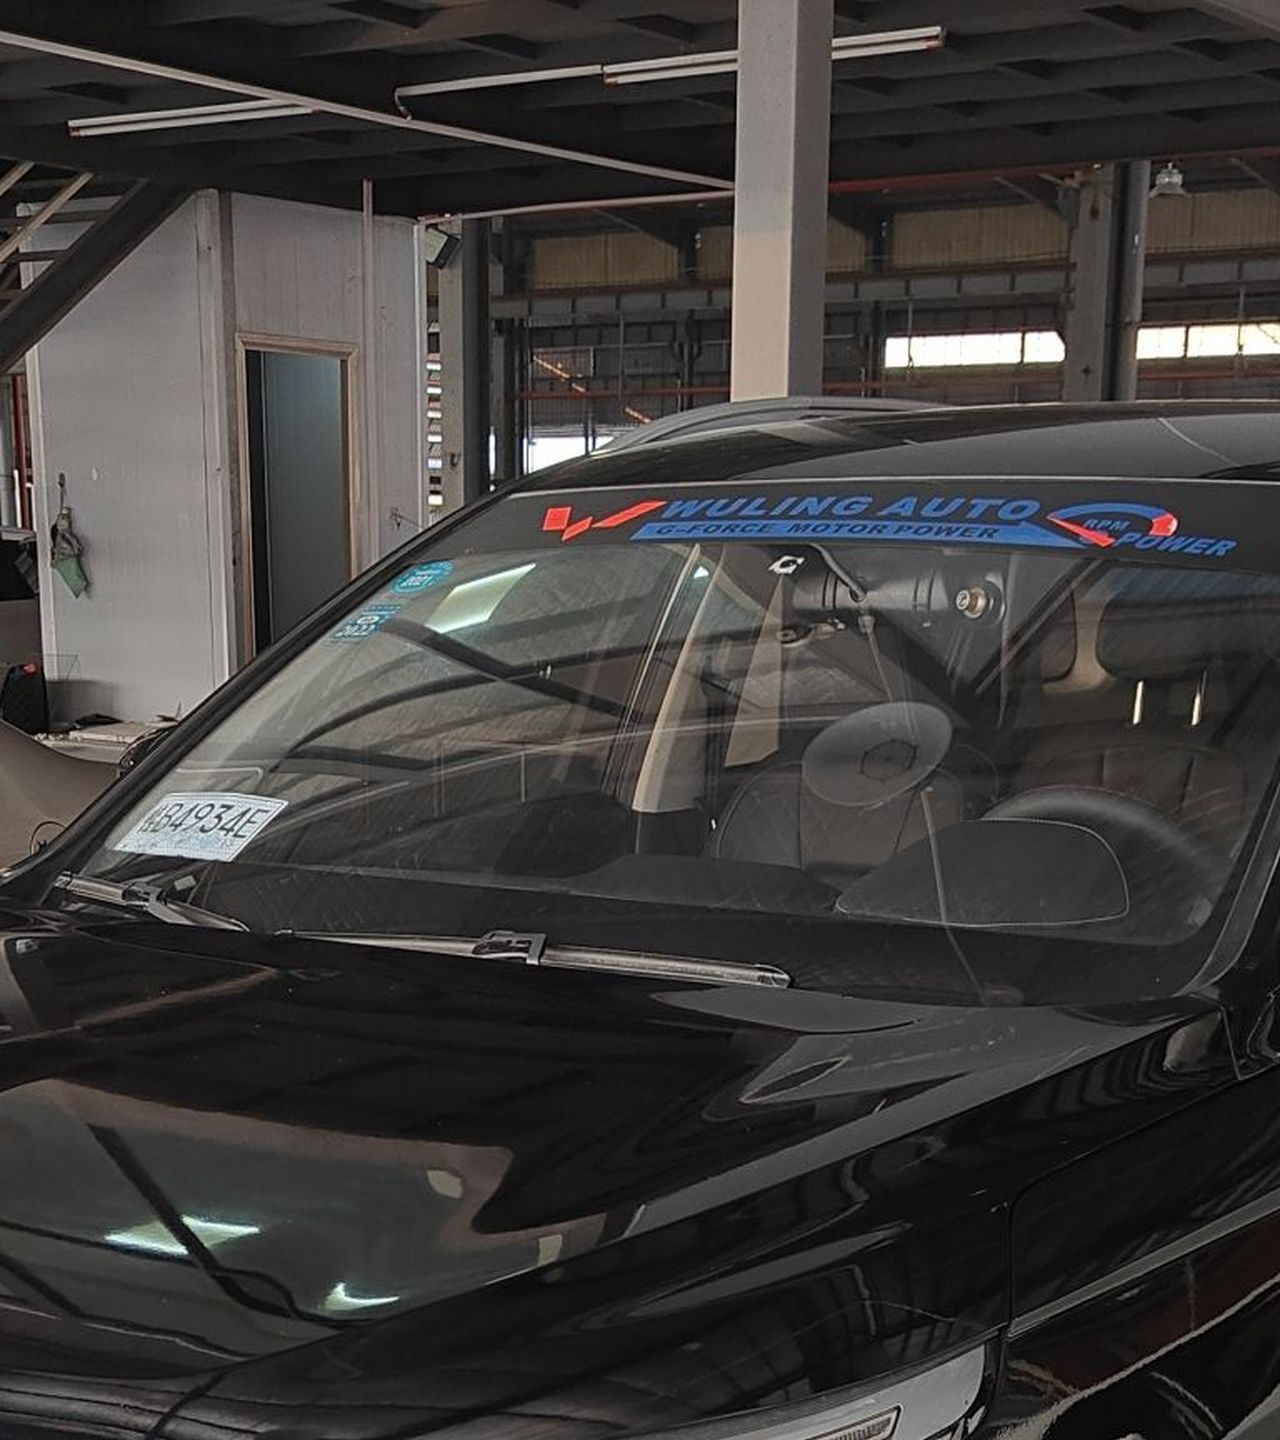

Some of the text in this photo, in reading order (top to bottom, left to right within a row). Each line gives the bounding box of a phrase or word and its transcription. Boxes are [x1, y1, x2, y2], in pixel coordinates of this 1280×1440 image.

[661, 496, 1041, 521] WULING AUTO
[655, 522, 1001, 539] G-FORCE MOTOR POWER
[1083, 517, 1132, 532] RPM
[1112, 531, 1238, 557] POWER
